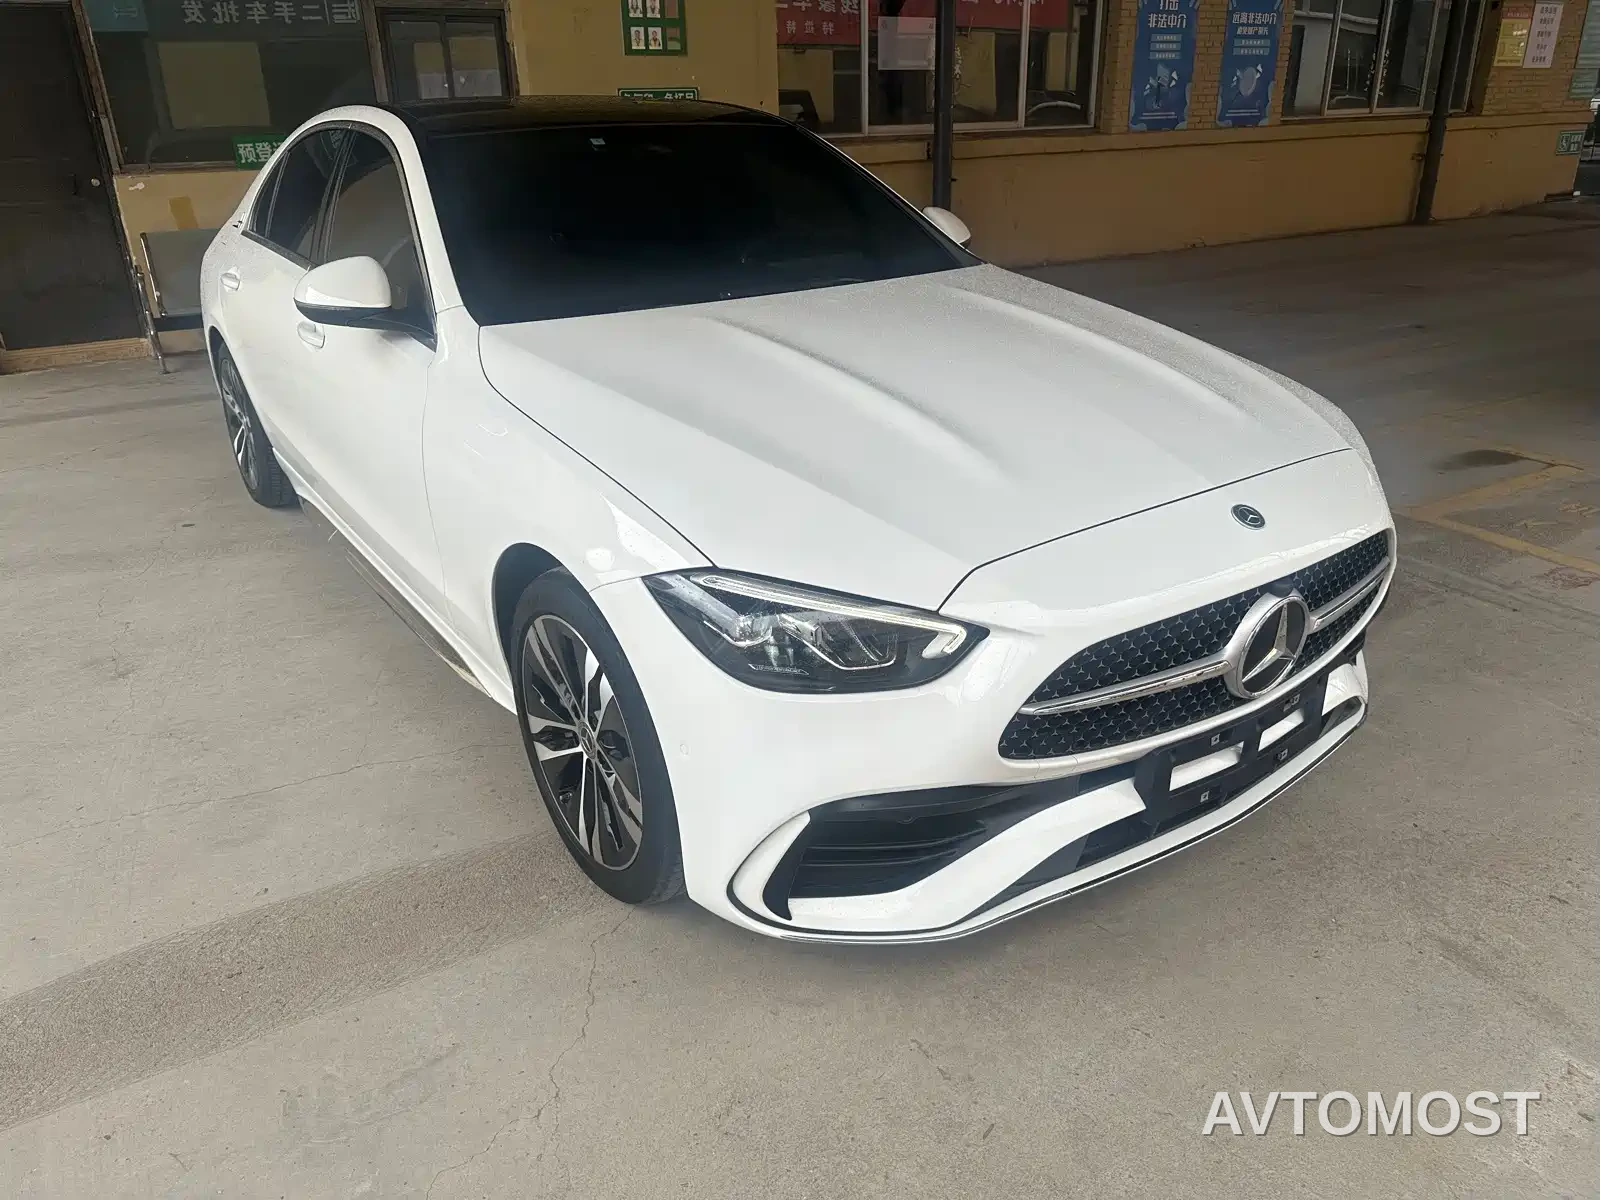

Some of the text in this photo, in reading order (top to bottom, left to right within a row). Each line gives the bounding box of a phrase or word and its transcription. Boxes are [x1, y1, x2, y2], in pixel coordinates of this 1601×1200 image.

[1148, 13, 1187, 29] 非法中介
[1232, 12, 1277, 25] 远离非法中介
